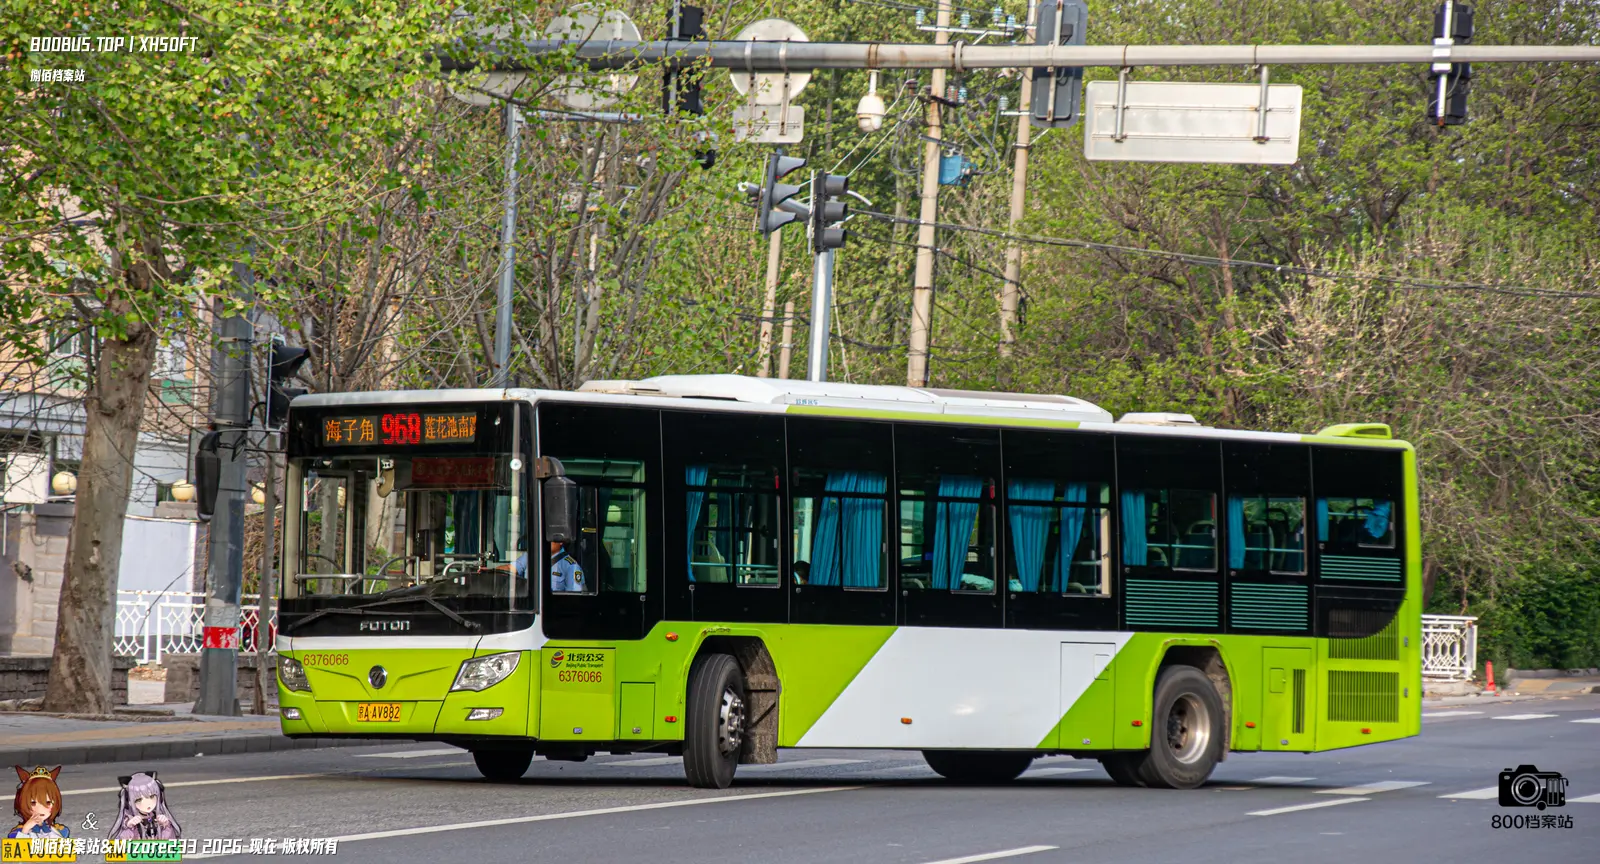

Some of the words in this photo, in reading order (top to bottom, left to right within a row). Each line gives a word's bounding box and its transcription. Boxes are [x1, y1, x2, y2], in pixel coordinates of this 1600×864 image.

[325, 418, 374, 442] 海子角
[381, 413, 421, 444] 968
[360, 620, 410, 631] FOTON
[303, 653, 349, 666] 6376066
[566, 653, 604, 662] 北京公交
[558, 670, 602, 683] 6376066
